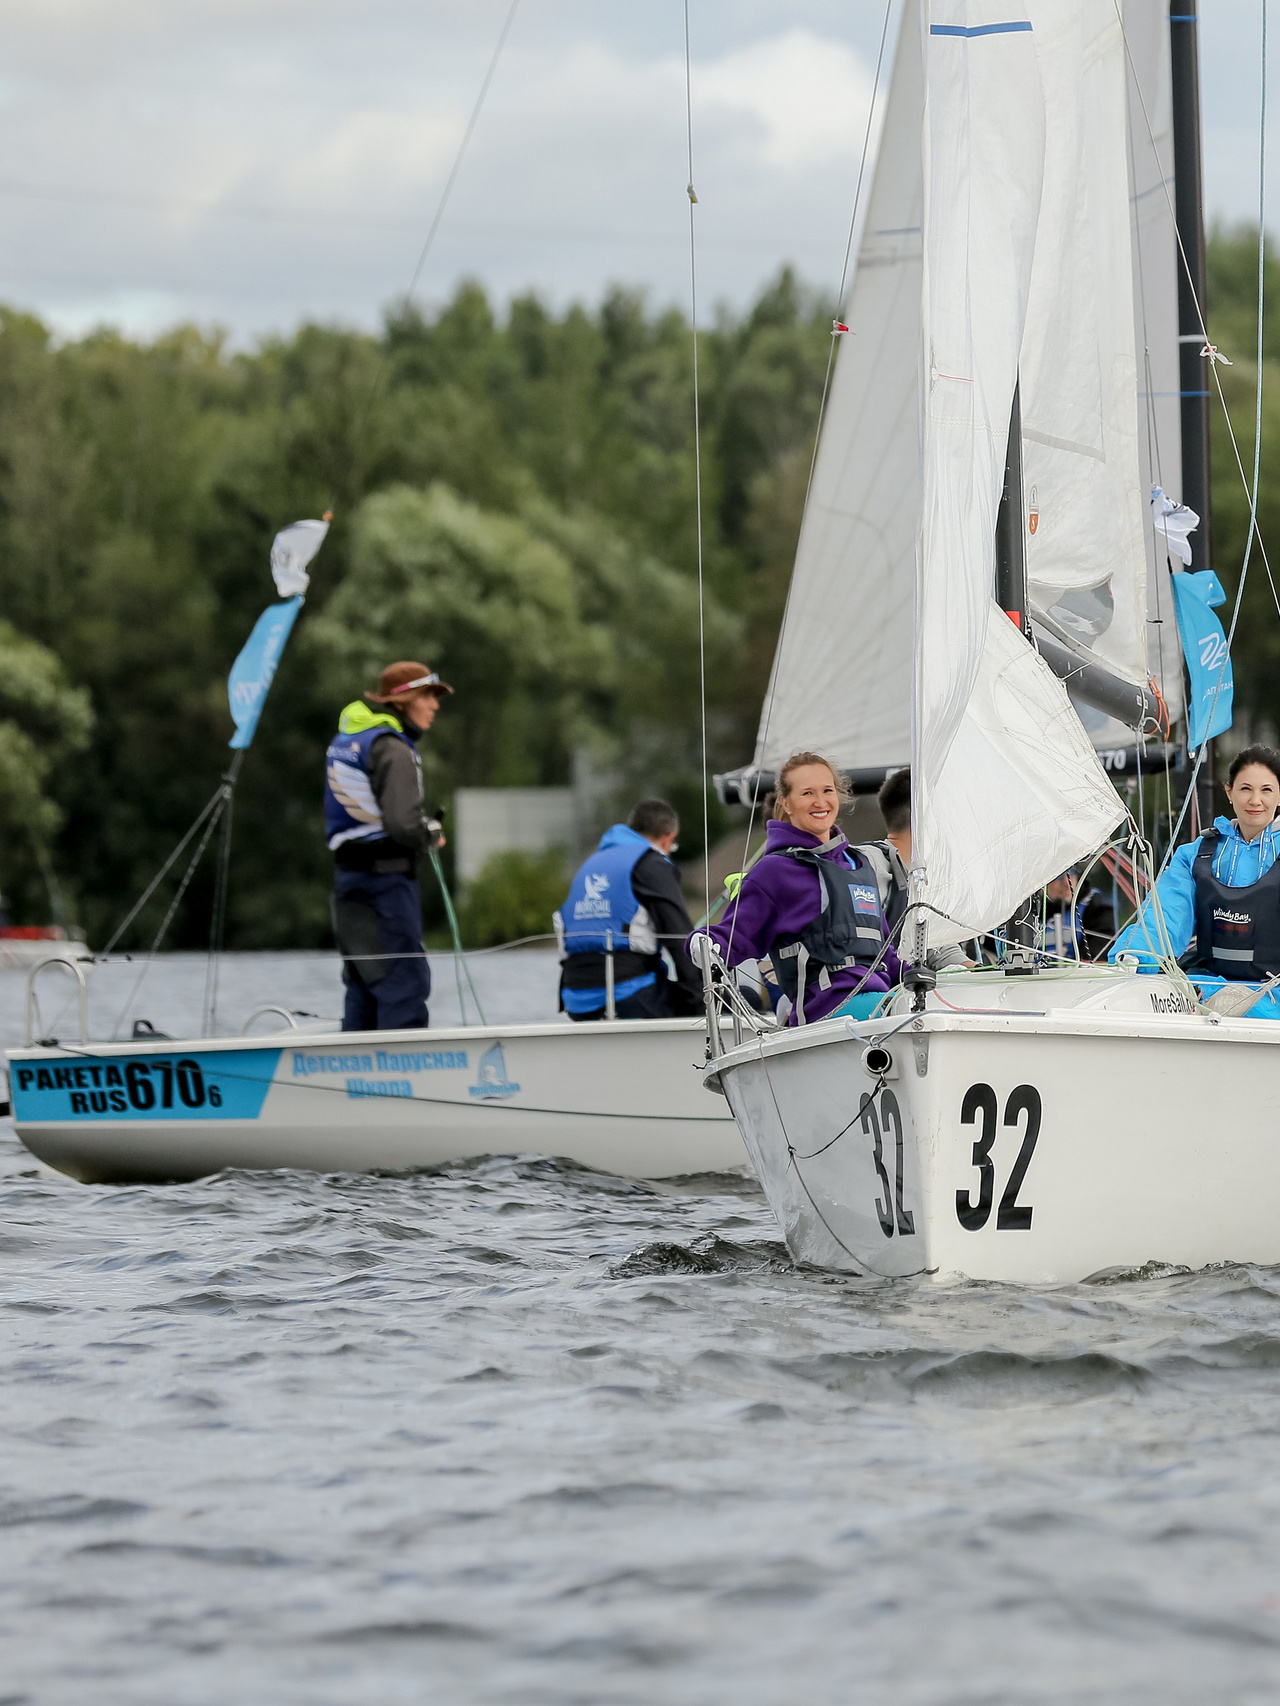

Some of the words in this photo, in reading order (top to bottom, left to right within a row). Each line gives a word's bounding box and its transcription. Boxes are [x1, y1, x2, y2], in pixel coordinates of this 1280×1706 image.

[293, 1053, 373, 1076] Детская
[375, 1051, 469, 1072] Парусная
[18, 1065, 125, 1091] РАКЕТА
[346, 1079, 414, 1099] Школа
[70, 1091, 128, 1114] RUS
[860, 1088, 916, 1239] 32
[955, 1082, 1042, 1232] 32
